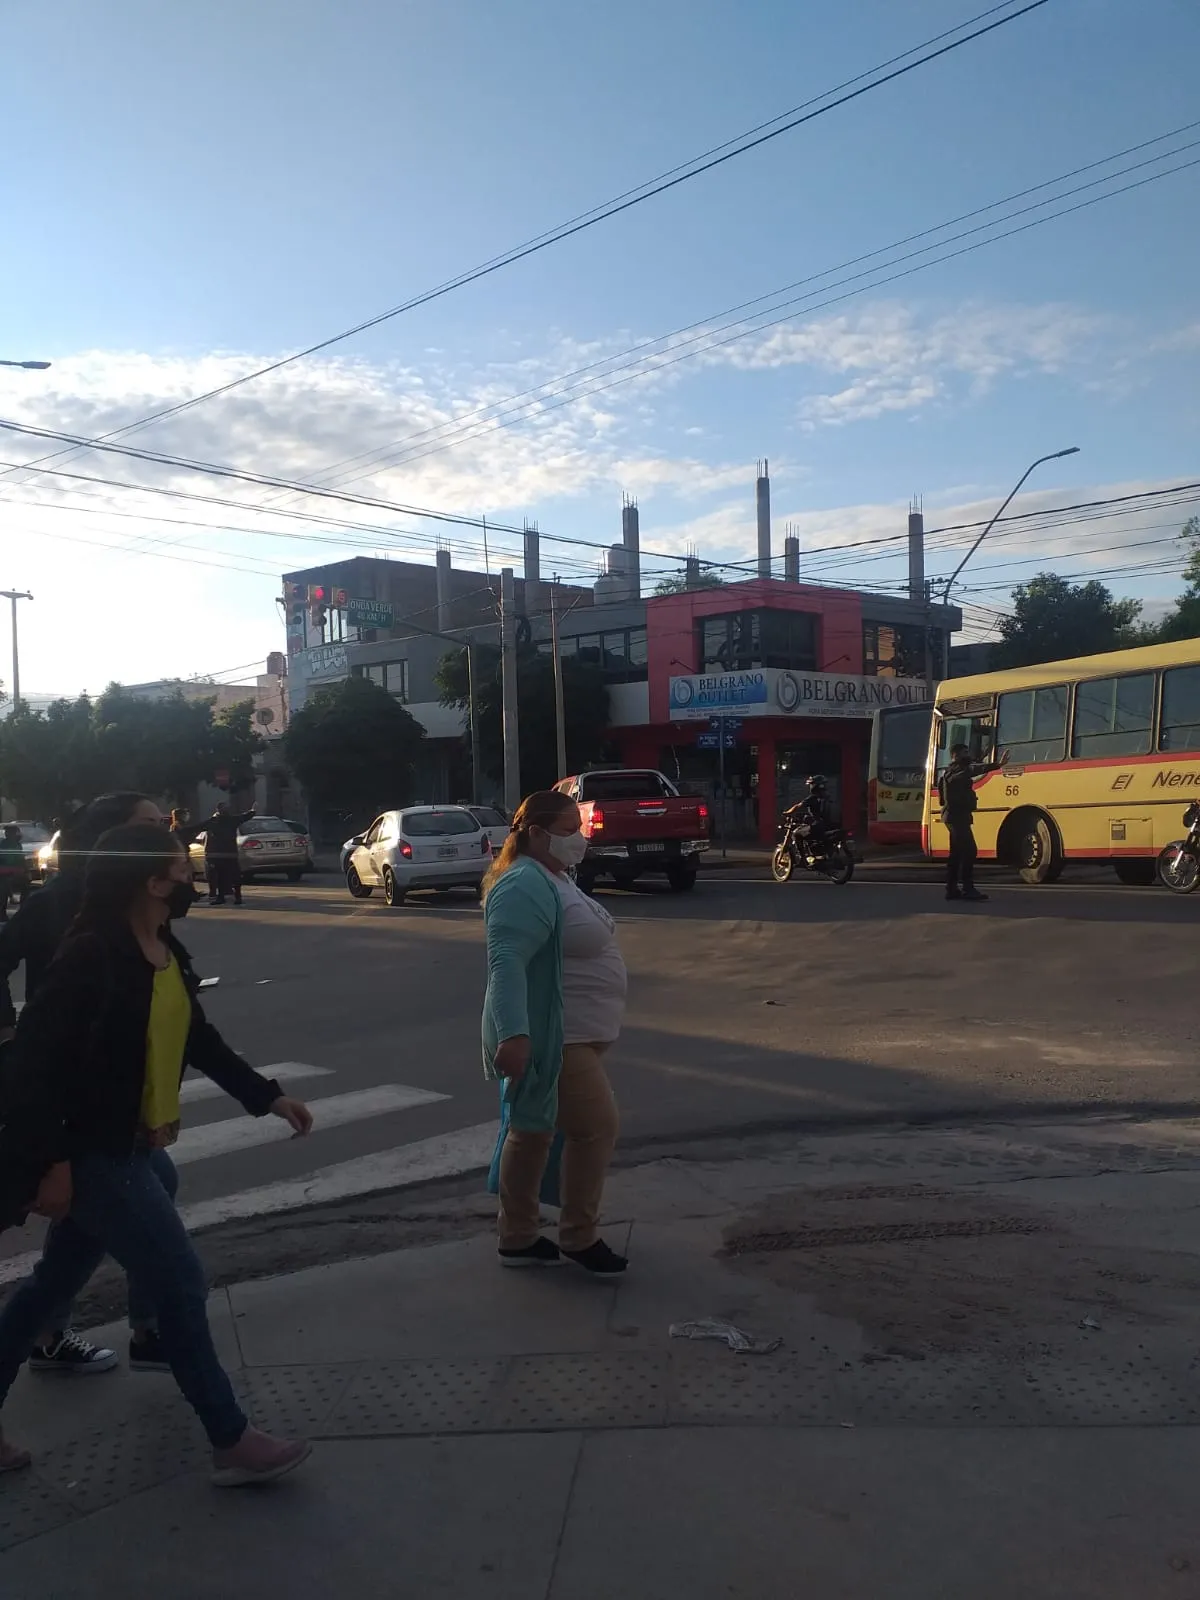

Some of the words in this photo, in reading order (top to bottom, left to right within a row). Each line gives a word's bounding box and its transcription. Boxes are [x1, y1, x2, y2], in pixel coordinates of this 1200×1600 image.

[350, 600, 369, 611] ONDA
[370, 602, 393, 614] VERDE
[699, 673, 763, 690] BELGRANO
[699, 688, 746, 702] OUTLET
[802, 679, 892, 703] BELGRANO
[1111, 774, 1135, 790] El
[1005, 785, 1020, 796] 56
